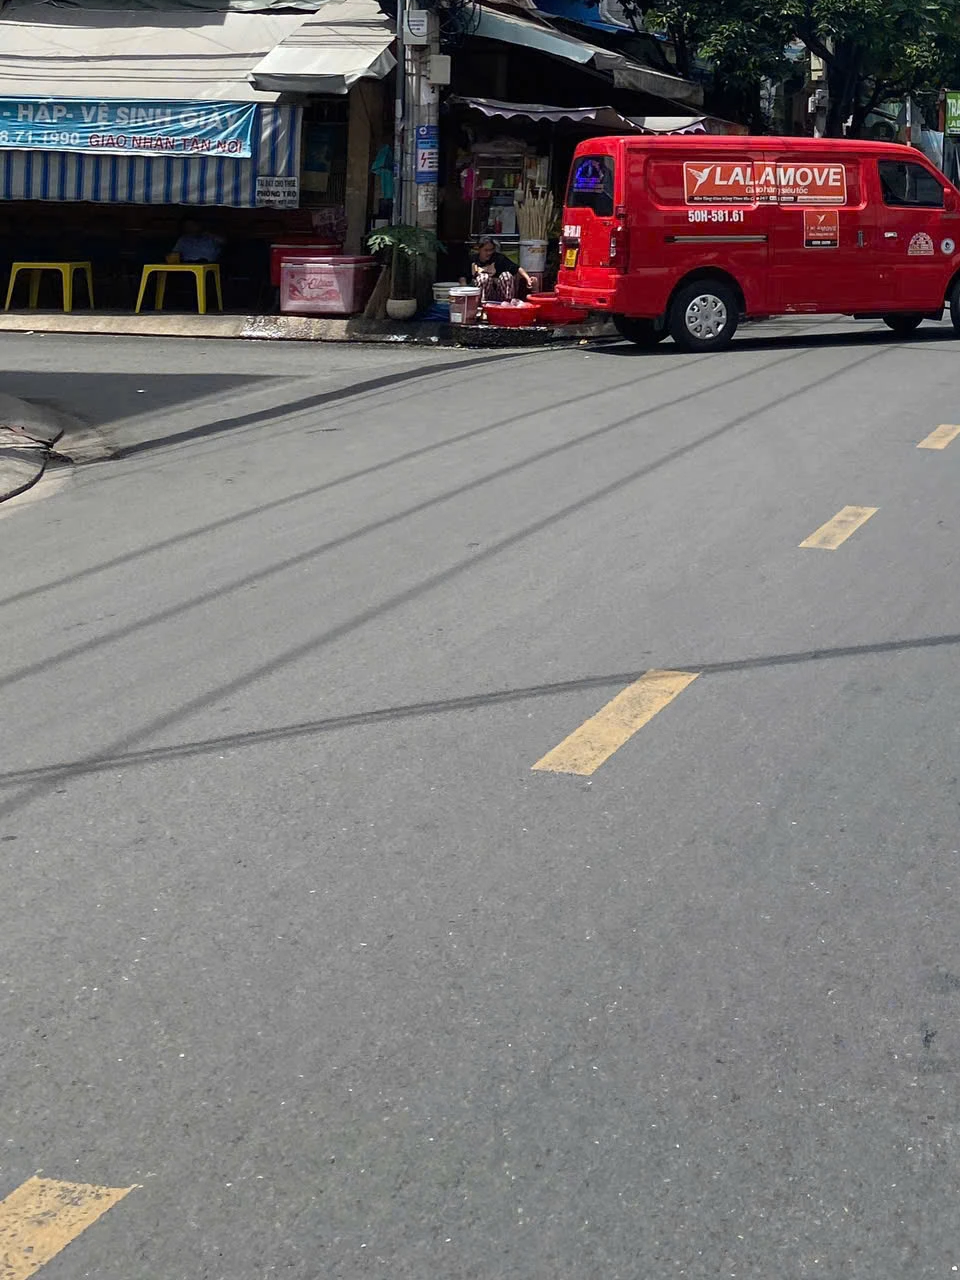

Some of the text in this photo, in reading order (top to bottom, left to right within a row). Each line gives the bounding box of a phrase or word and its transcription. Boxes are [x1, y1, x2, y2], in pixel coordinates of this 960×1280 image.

[115, 106, 172, 126] SINH
[89, 133, 128, 147] GIAO
[714, 166, 842, 187] LALAMOVE
[688, 209, 744, 223] 50H-581.61
